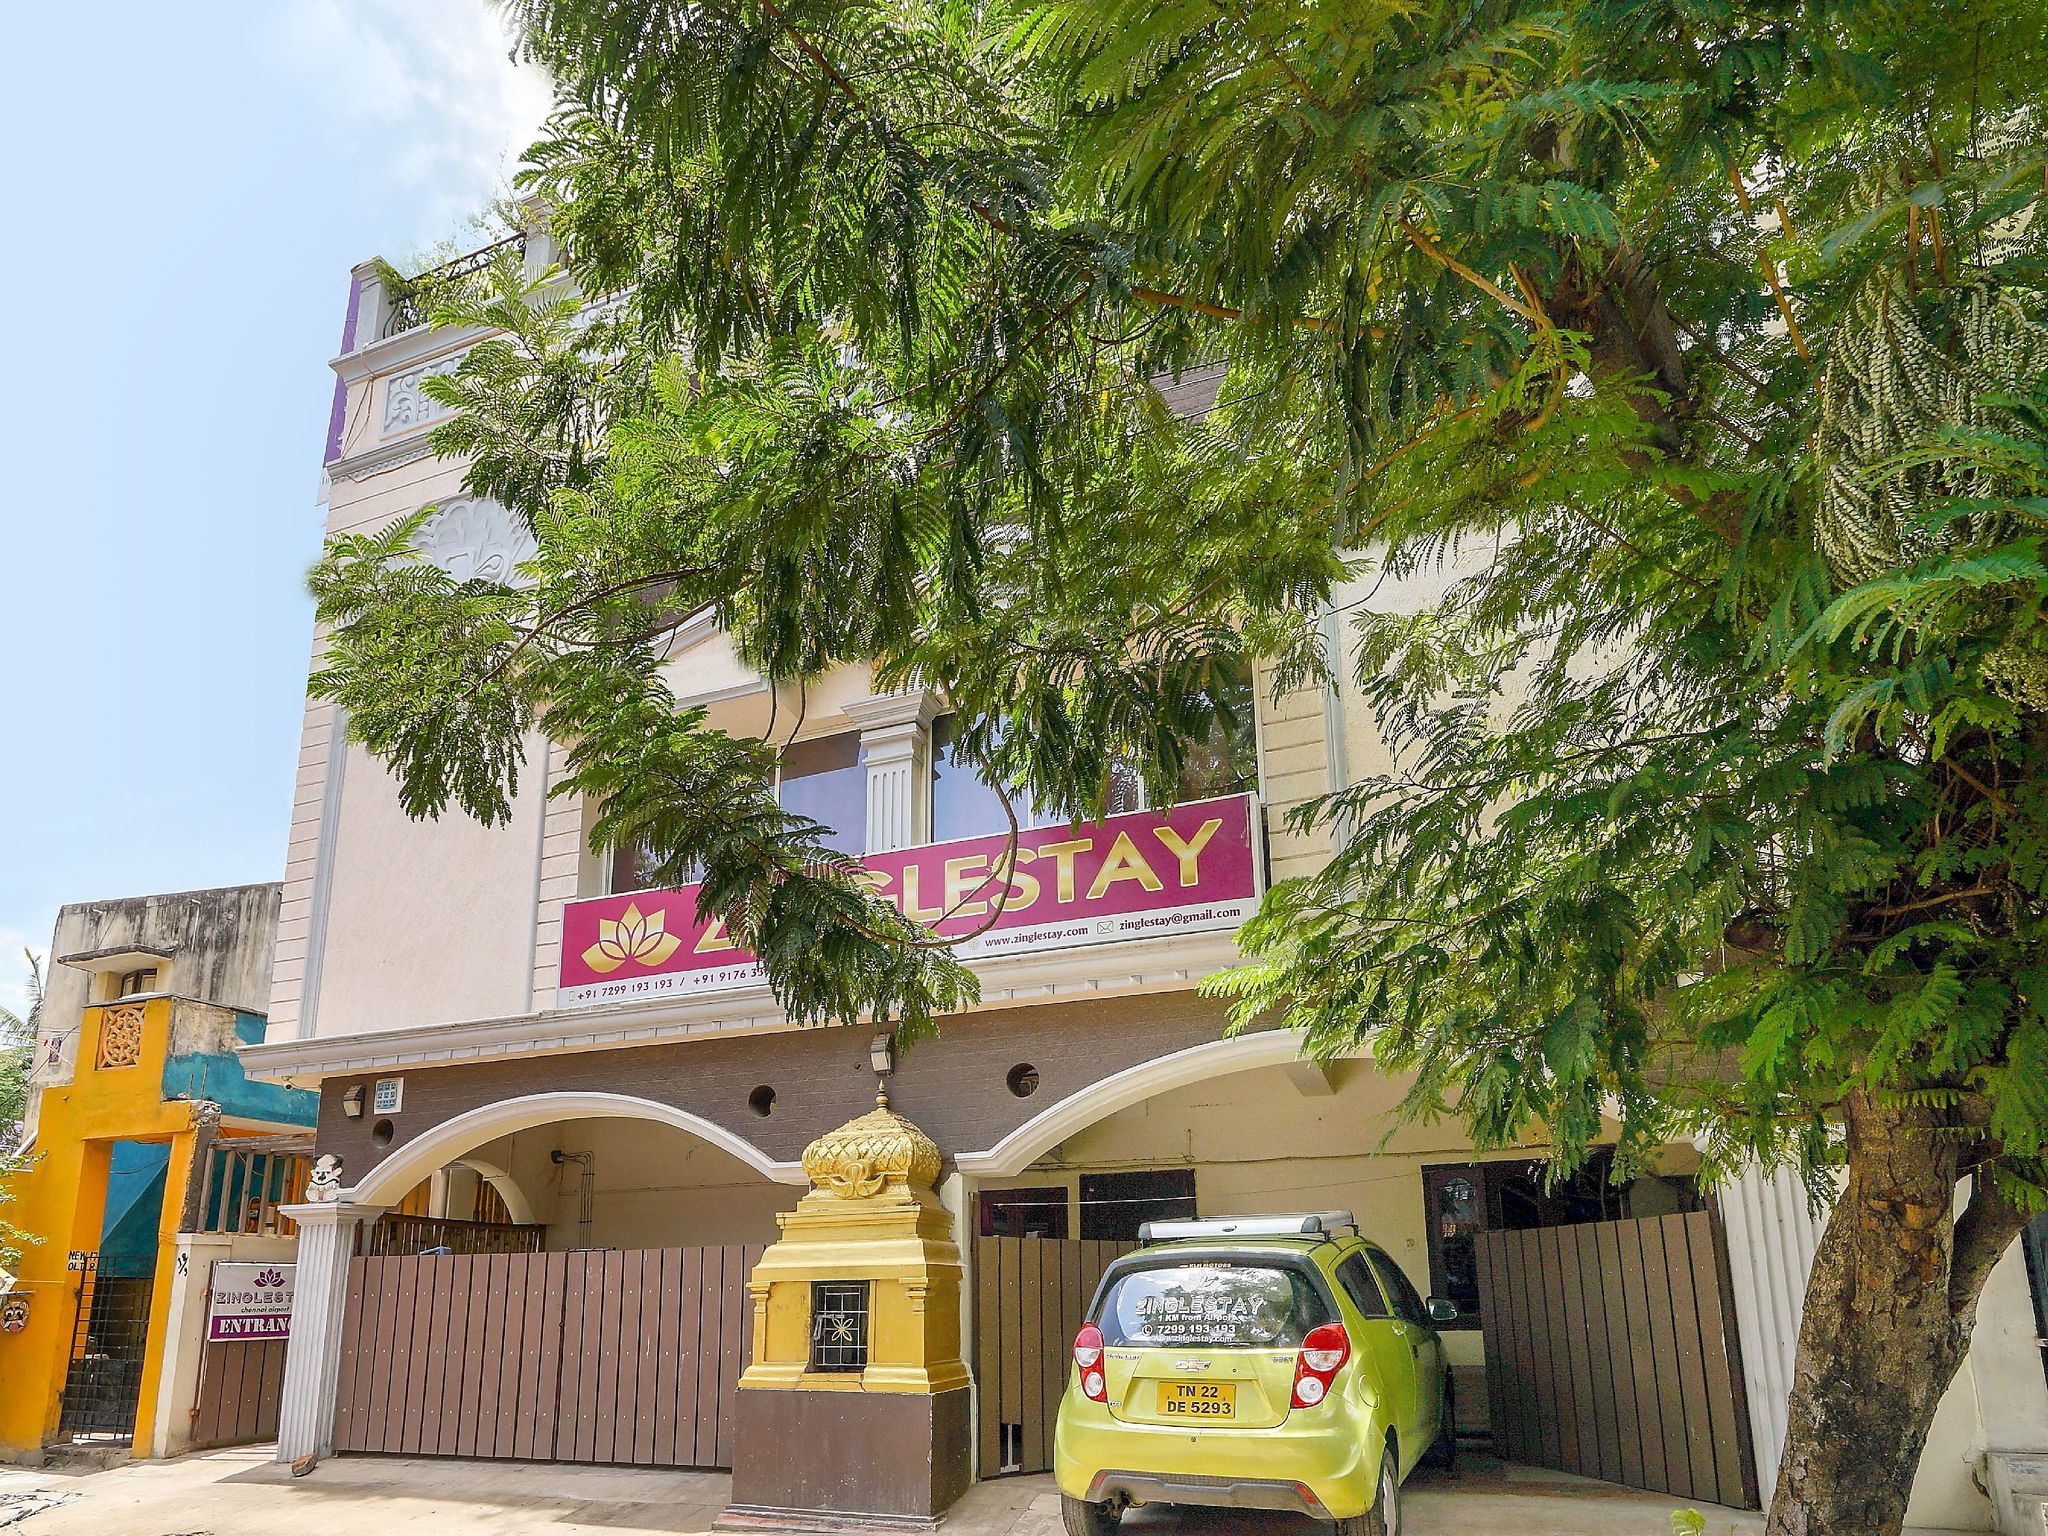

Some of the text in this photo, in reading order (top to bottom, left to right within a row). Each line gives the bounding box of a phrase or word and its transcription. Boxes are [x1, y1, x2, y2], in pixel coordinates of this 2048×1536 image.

[985, 908, 1241, 947] www.zinglestay.com zinglestay@gmail.com
[578, 989, 597, 1000] +91
[602, 985, 627, 997] 7299
[632, 982, 649, 993] 193
[655, 978, 673, 989] 193
[693, 973, 714, 985] +91
[719, 969, 747, 982] 9176
[268, 1306, 289, 1315] airport
[1135, 1296, 1265, 1315] ZINGLESTAY
[219, 1318, 291, 1333] ENTRAN
[1158, 1324, 1236, 1333] 7299 193 193
[1177, 1386, 1218, 1398] TN 22
[1168, 1401, 1232, 1414] DE 5293
